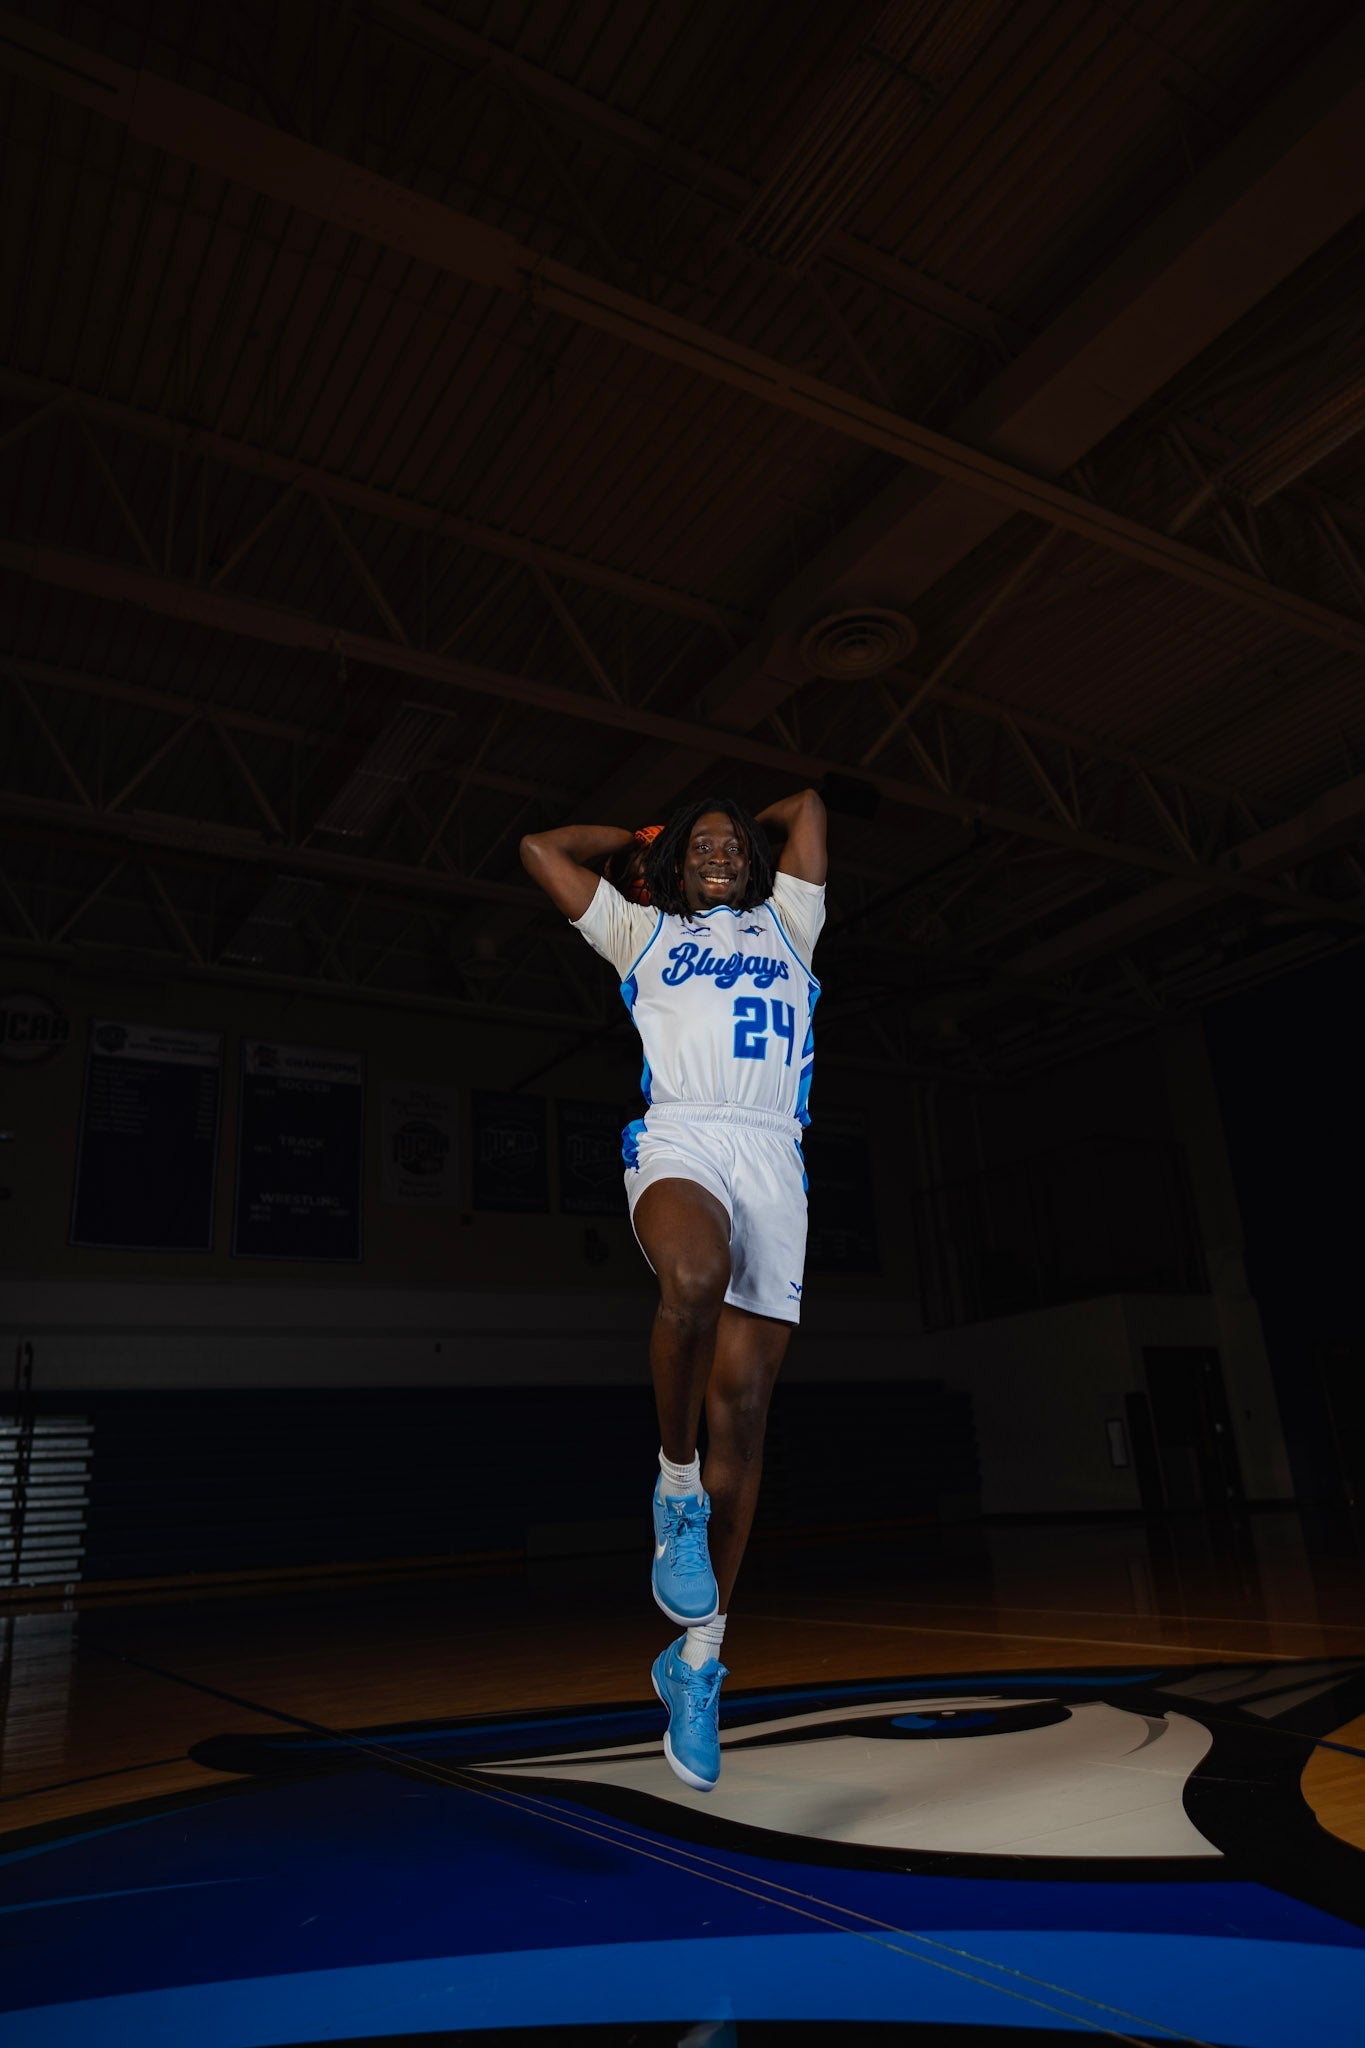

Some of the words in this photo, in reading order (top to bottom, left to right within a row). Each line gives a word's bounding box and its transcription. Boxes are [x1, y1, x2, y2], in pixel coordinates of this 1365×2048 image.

[661, 942, 789, 989] Bluejays
[733, 996, 795, 1067] 24
[278, 1134, 327, 1150] TRACK
[259, 1192, 340, 1208] WRESTLING
